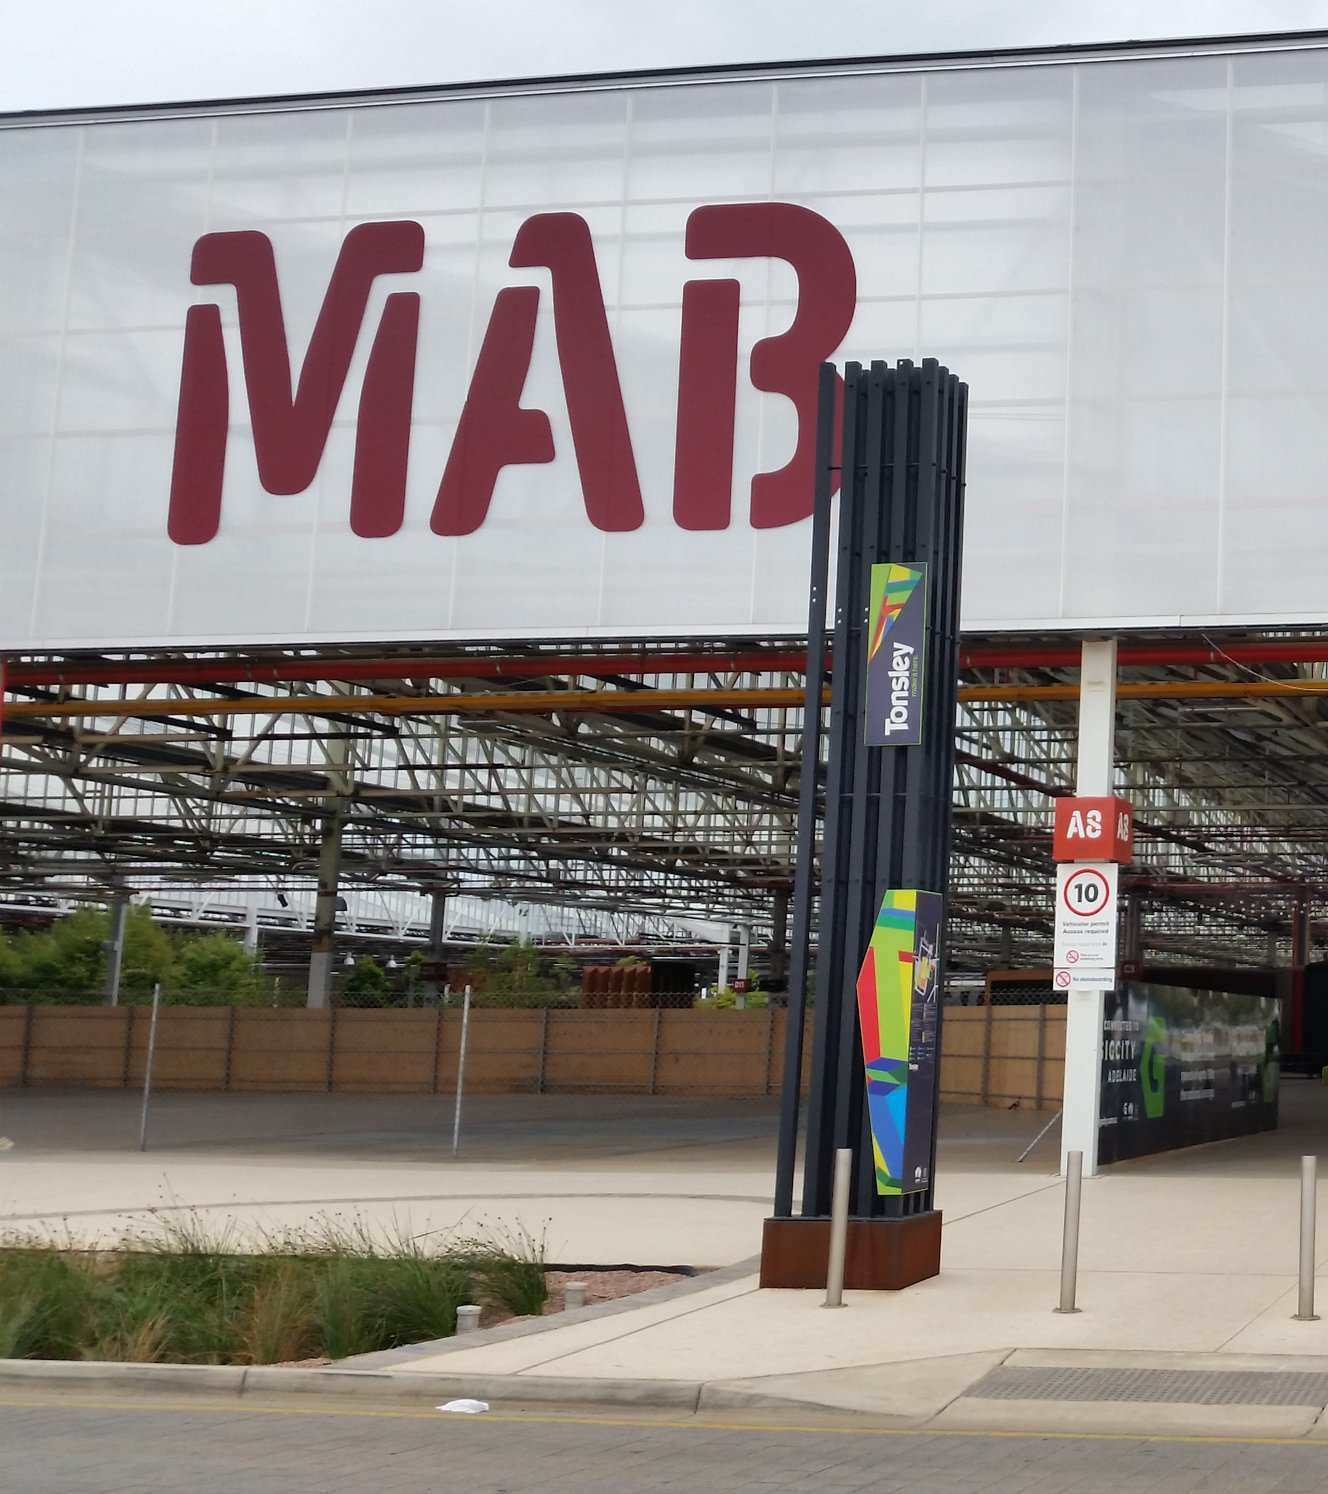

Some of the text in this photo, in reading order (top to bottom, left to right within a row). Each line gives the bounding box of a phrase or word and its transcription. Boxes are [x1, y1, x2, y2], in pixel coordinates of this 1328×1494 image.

[167, 202, 857, 545] MAB
[884, 641, 915, 736] Tonsley
[1066, 809, 1102, 839] A8
[1116, 811, 1129, 842] A8
[1074, 883, 1099, 903] 10
[1100, 1039, 1136, 1060] IGCITY
[1107, 1069, 1137, 1083] ADELAIDE
